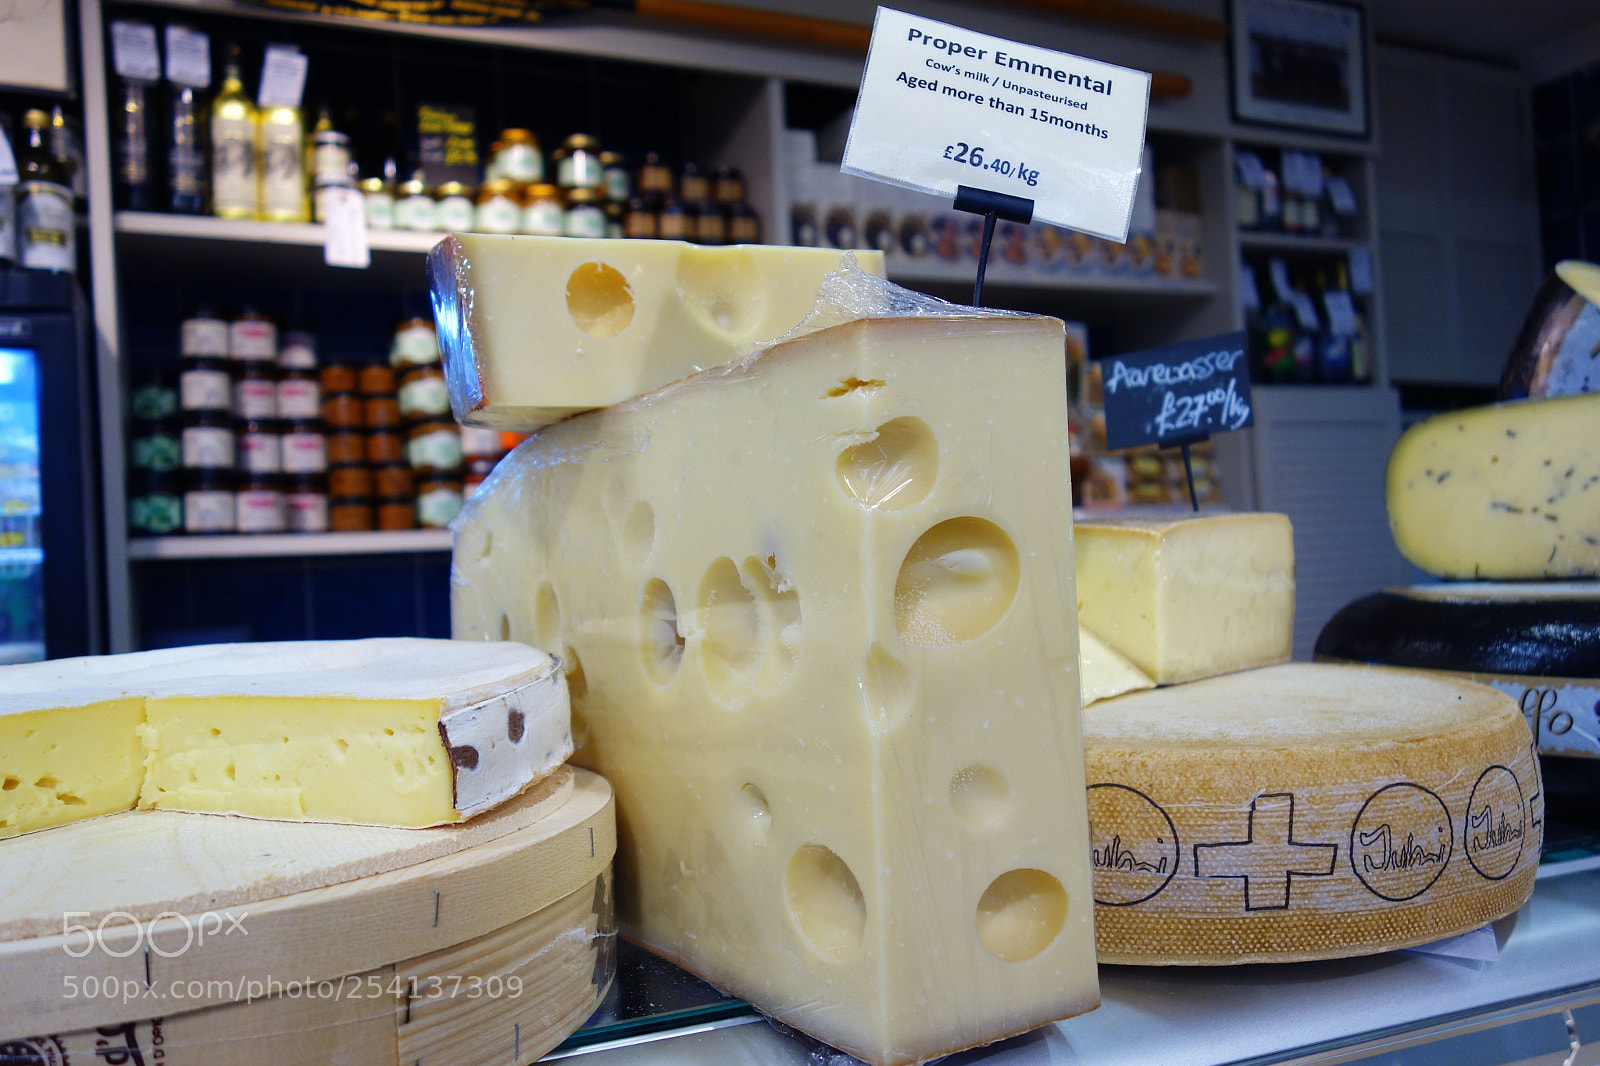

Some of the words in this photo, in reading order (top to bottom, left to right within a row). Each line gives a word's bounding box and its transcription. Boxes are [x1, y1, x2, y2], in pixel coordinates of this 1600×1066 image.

[907, 27, 988, 60] Proper
[995, 51, 1113, 96] Emmental
[925, 58, 962, 76] Cow's
[964, 68, 990, 84] milk
[1002, 80, 1088, 111] Unpasteurised
[896, 71, 938, 92] Aged
[942, 87, 985, 105] more
[988, 96, 1025, 117] than
[1029, 107, 1109, 139] 15months
